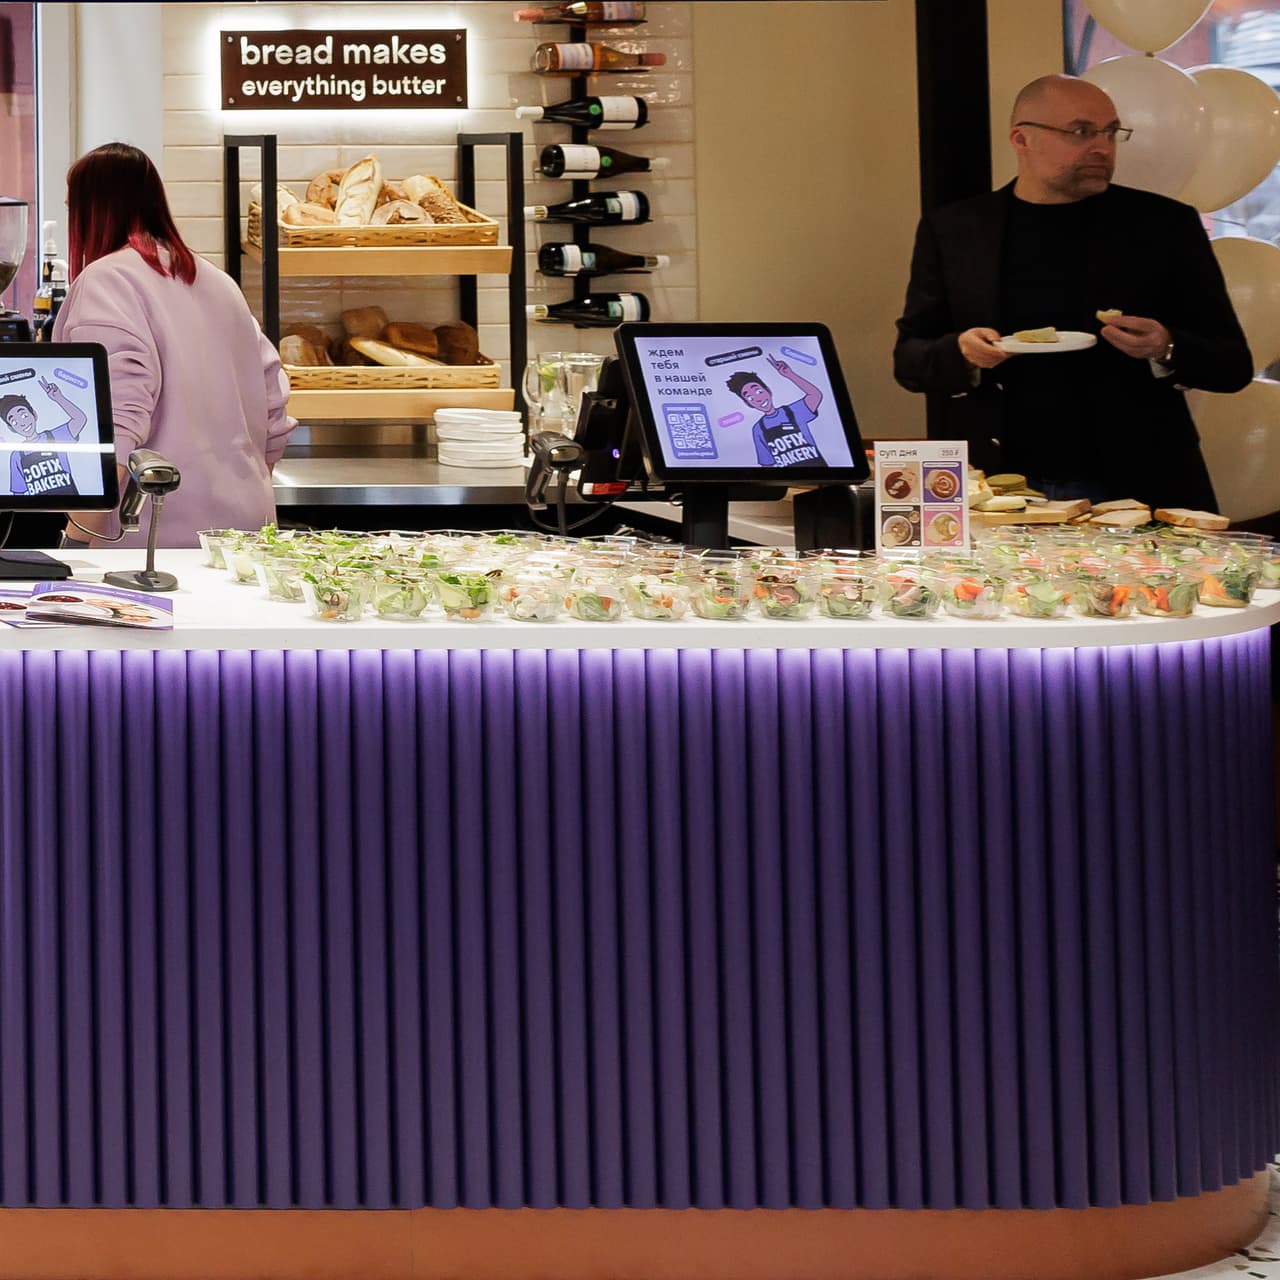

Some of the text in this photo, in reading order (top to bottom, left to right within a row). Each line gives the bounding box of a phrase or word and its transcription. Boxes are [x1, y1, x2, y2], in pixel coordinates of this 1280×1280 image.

[240, 36, 446, 65] bread makes
[242, 74, 446, 102] everything butter
[648, 349, 684, 357] ждем
[651, 360, 679, 369] тебя
[665, 373, 706, 383] нашей
[658, 388, 712, 396] команде
[768, 432, 807, 456] COFIX
[880, 450, 897, 459] суп
[24, 458, 62, 480] COFIX
[28, 473, 72, 495] BAKERY
